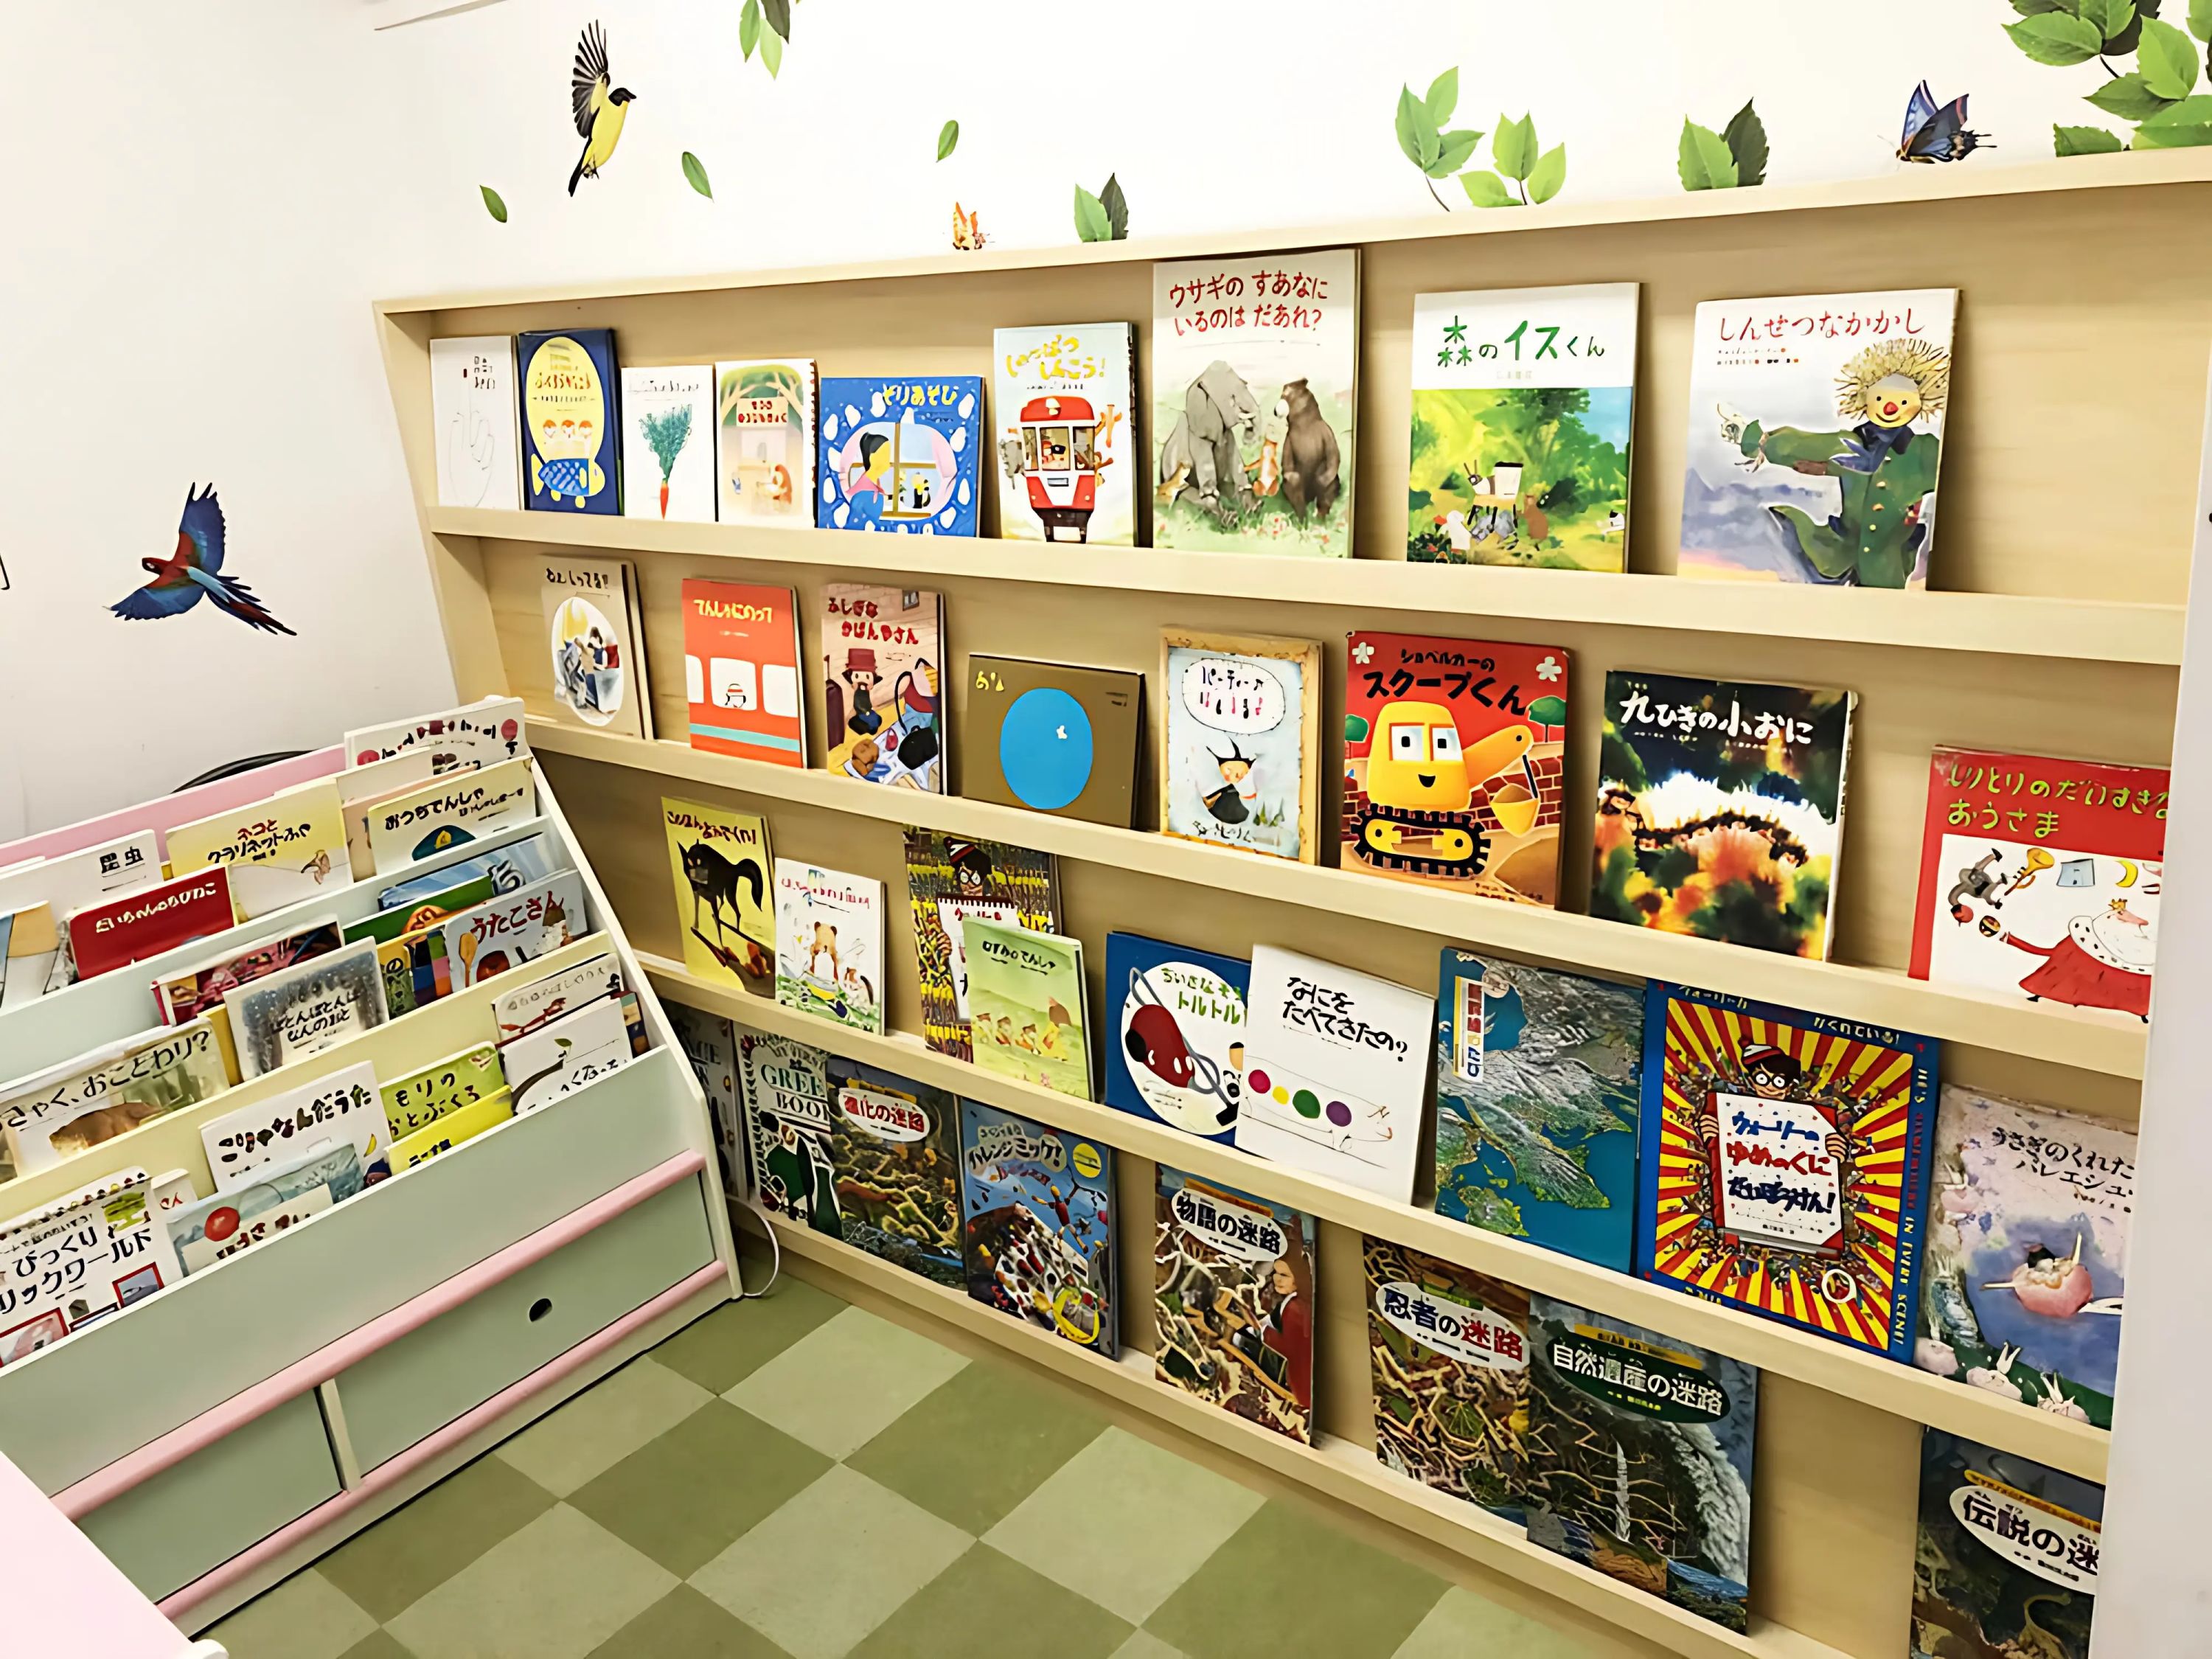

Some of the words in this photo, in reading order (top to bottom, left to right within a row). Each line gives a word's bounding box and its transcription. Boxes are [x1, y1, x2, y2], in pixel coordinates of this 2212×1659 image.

[1169, 273, 1244, 308] ウサギの
[1251, 270, 1328, 299] すあなに
[1175, 305, 1245, 336] いるのは
[1253, 303, 1322, 332] だあれ?
[1437, 315, 1605, 367] 森のイスくん
[1719, 308, 1925, 341] しんせつなかかし
[1401, 649, 1495, 672] ショベルカーの
[1363, 669, 1526, 716] スクープくん
[1619, 690, 1814, 745] 九ひきの小おに
[1948, 799, 2059, 838] おうさま
[1287, 976, 1355, 1015] なにを
[0, 1031, 211, 1134] きゃく、おことわり?
[1992, 1125, 2136, 1180] うさぎのくれた
[11, 1226, 98, 1279] びっくり
[1383, 1285, 1524, 1363] 忍者の迷路
[1553, 1342, 1723, 1417] 自然遺産の迷路
[1963, 1492, 2101, 1576] 伝説の迷
